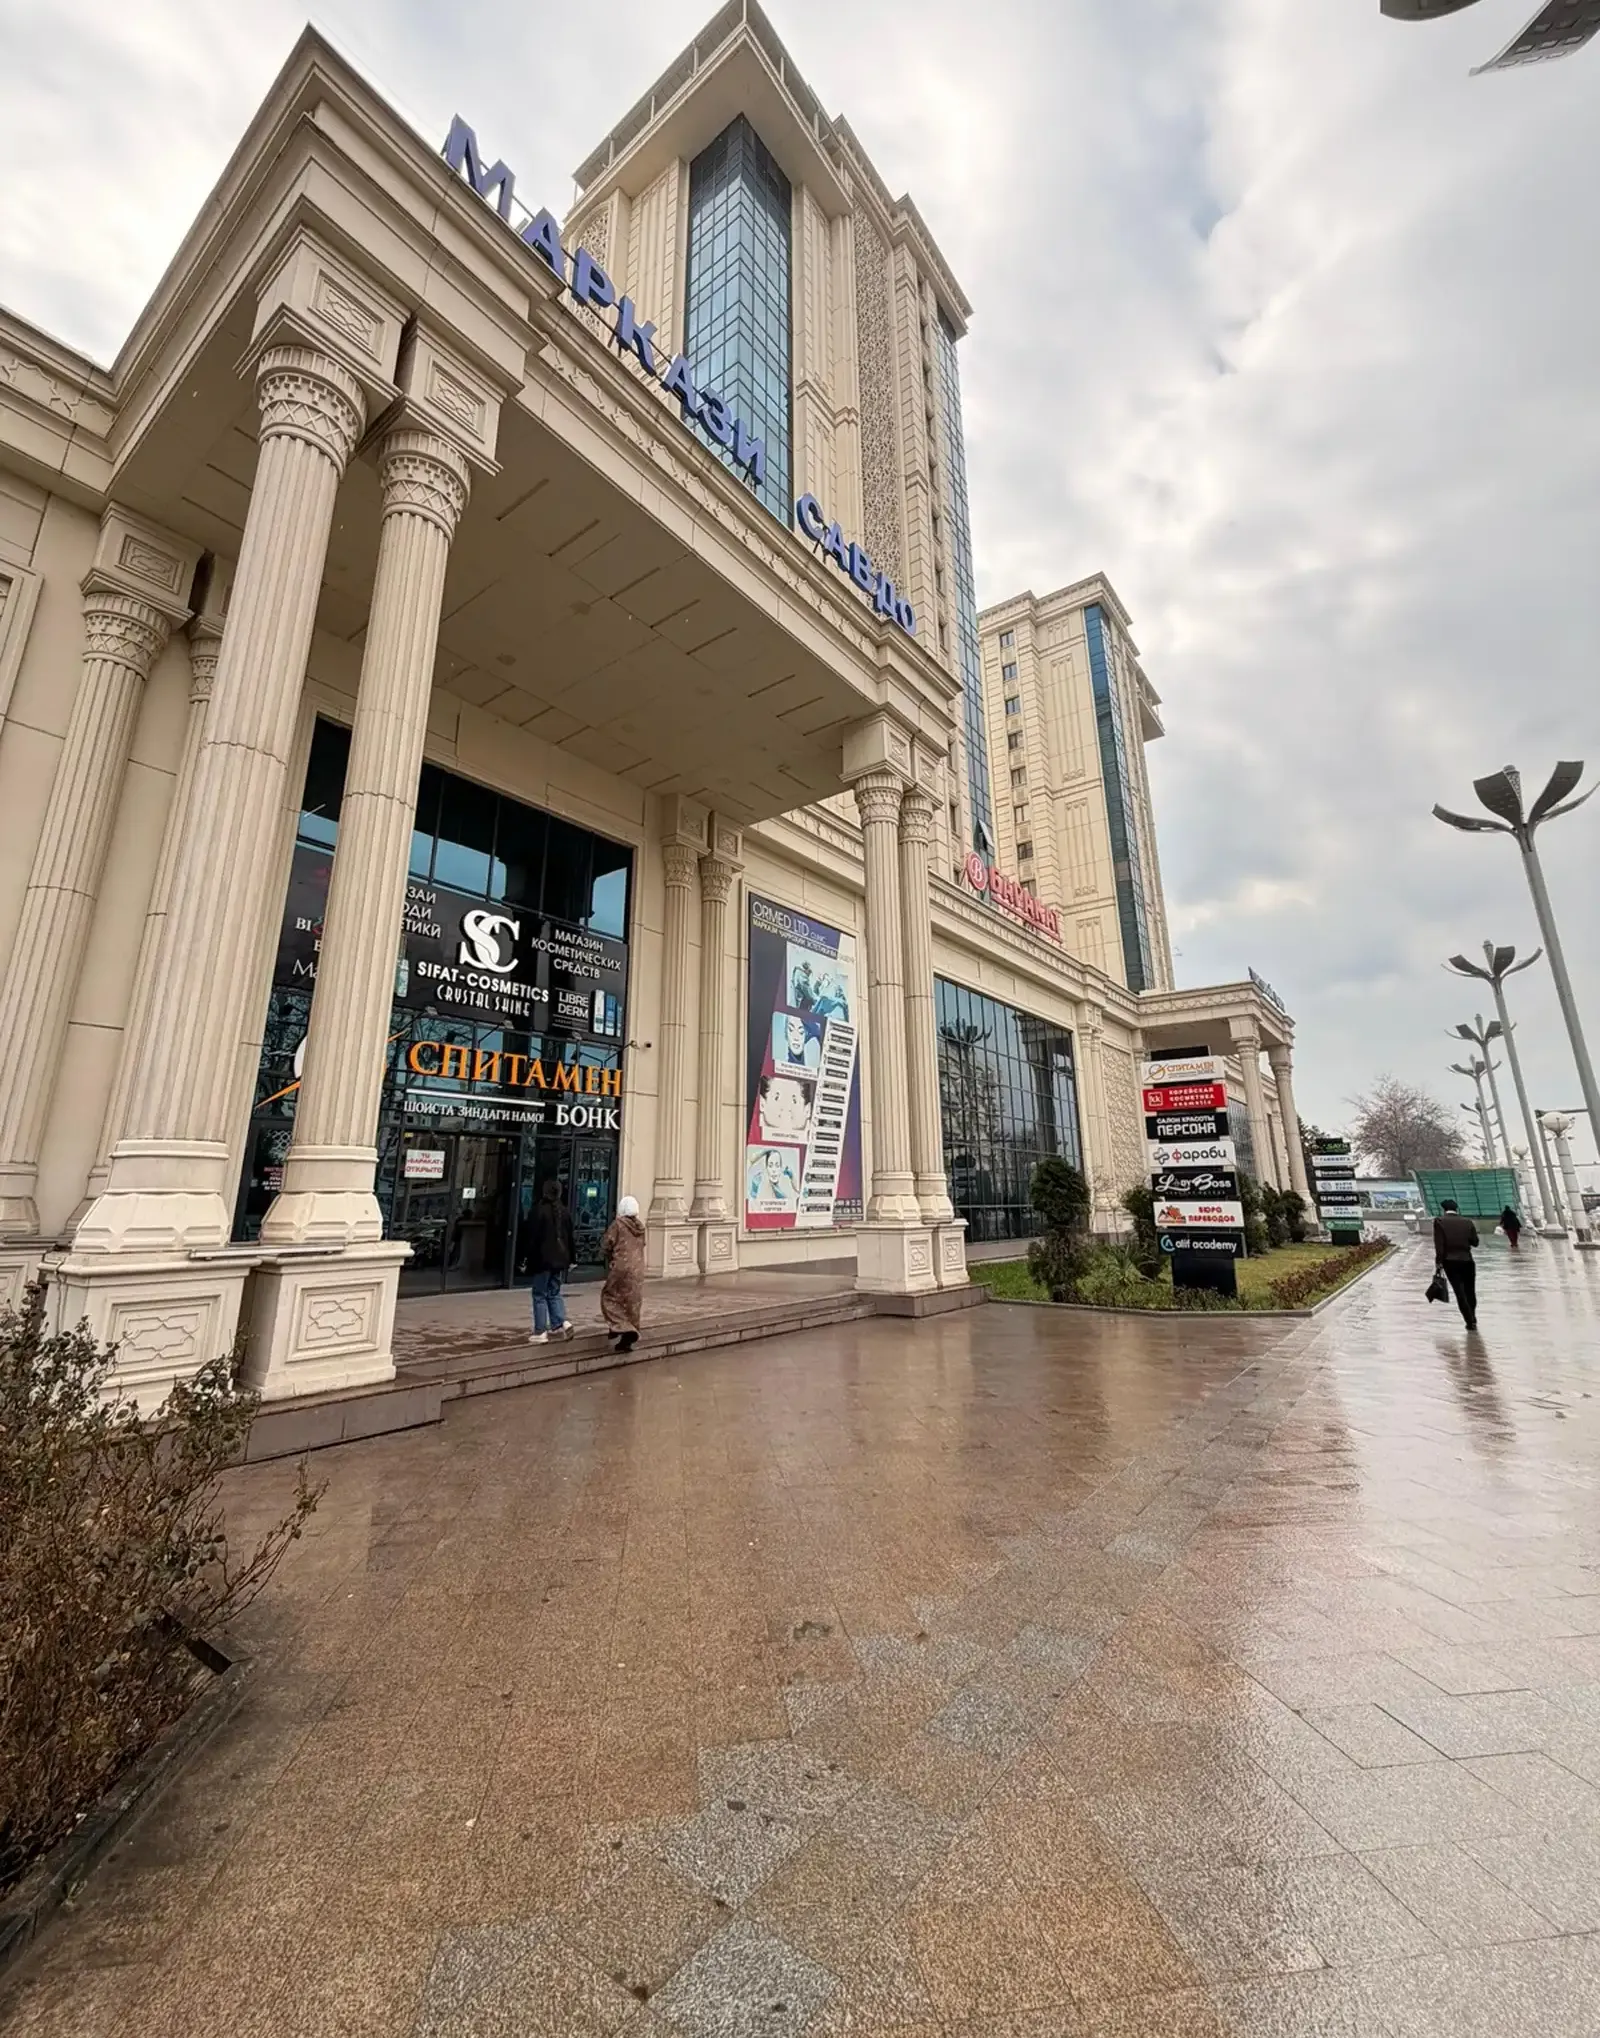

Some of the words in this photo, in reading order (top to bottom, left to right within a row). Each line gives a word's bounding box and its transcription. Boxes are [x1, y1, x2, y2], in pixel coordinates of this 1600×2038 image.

[441, 113, 765, 485] МАРКАЗИ
[797, 492, 916, 636] САВДО
[405, 886, 436, 904] ЗАИ
[989, 865, 1060, 935] БАРАКАТ
[753, 901, 792, 929] ORMED
[793, 919, 810, 937] LTD
[554, 929, 604, 952] МАГАЗИН
[531, 937, 622, 971] КОСМЕТИЧЕСКИХ
[553, 958, 601, 979] СРЕДСТВ
[417, 961, 549, 1003] SIFAT-COSMETICS
[436, 984, 490, 1009] CRYSTAL
[494, 996, 531, 1017] SHINE
[558, 991, 589, 1008] LIBRE
[557, 1003, 589, 1019] DERM
[409, 1041, 623, 1096] СПИТАМЕН
[1169, 1087, 1214, 1095] КОРЕЙСКАЯ
[404, 1100, 455, 1116] ШОИСТА
[511, 1110, 545, 1123] НАМО!
[555, 1103, 620, 1130] БОНК
[1182, 1115, 1215, 1123] КРАСОТЫ
[1156, 1123, 1217, 1136] ПЕРСОНА
[1172, 1146, 1227, 1163] фараби
[1188, 1215, 1235, 1223] ПЕРЕВОДОВ
[1192, 1239, 1237, 1253] academy
